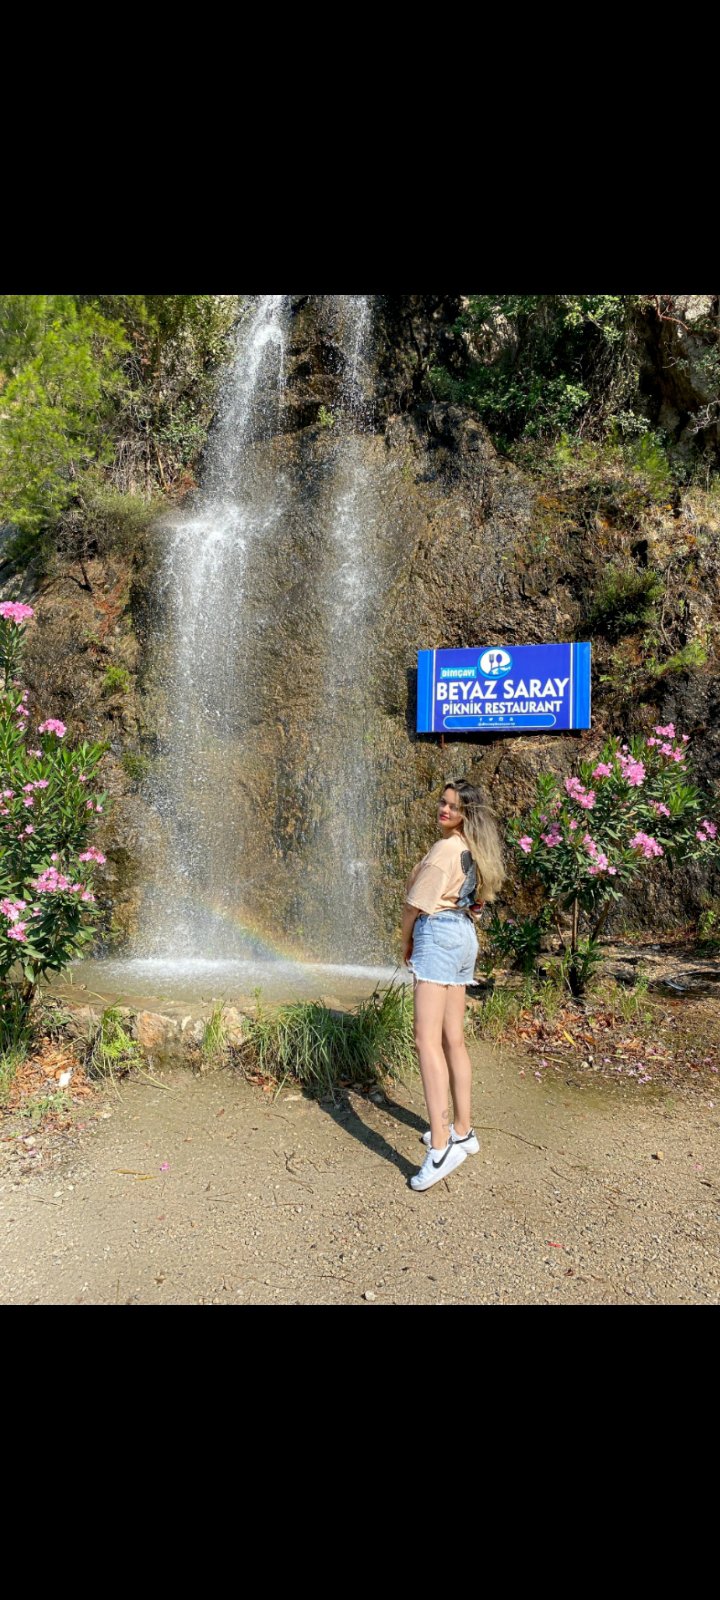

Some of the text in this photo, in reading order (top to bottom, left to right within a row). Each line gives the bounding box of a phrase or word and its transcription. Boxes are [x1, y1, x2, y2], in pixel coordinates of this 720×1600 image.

[436, 678, 569, 700] BEYAZ SARAY
[442, 700, 562, 715] PİKNİK RESTAURANT
